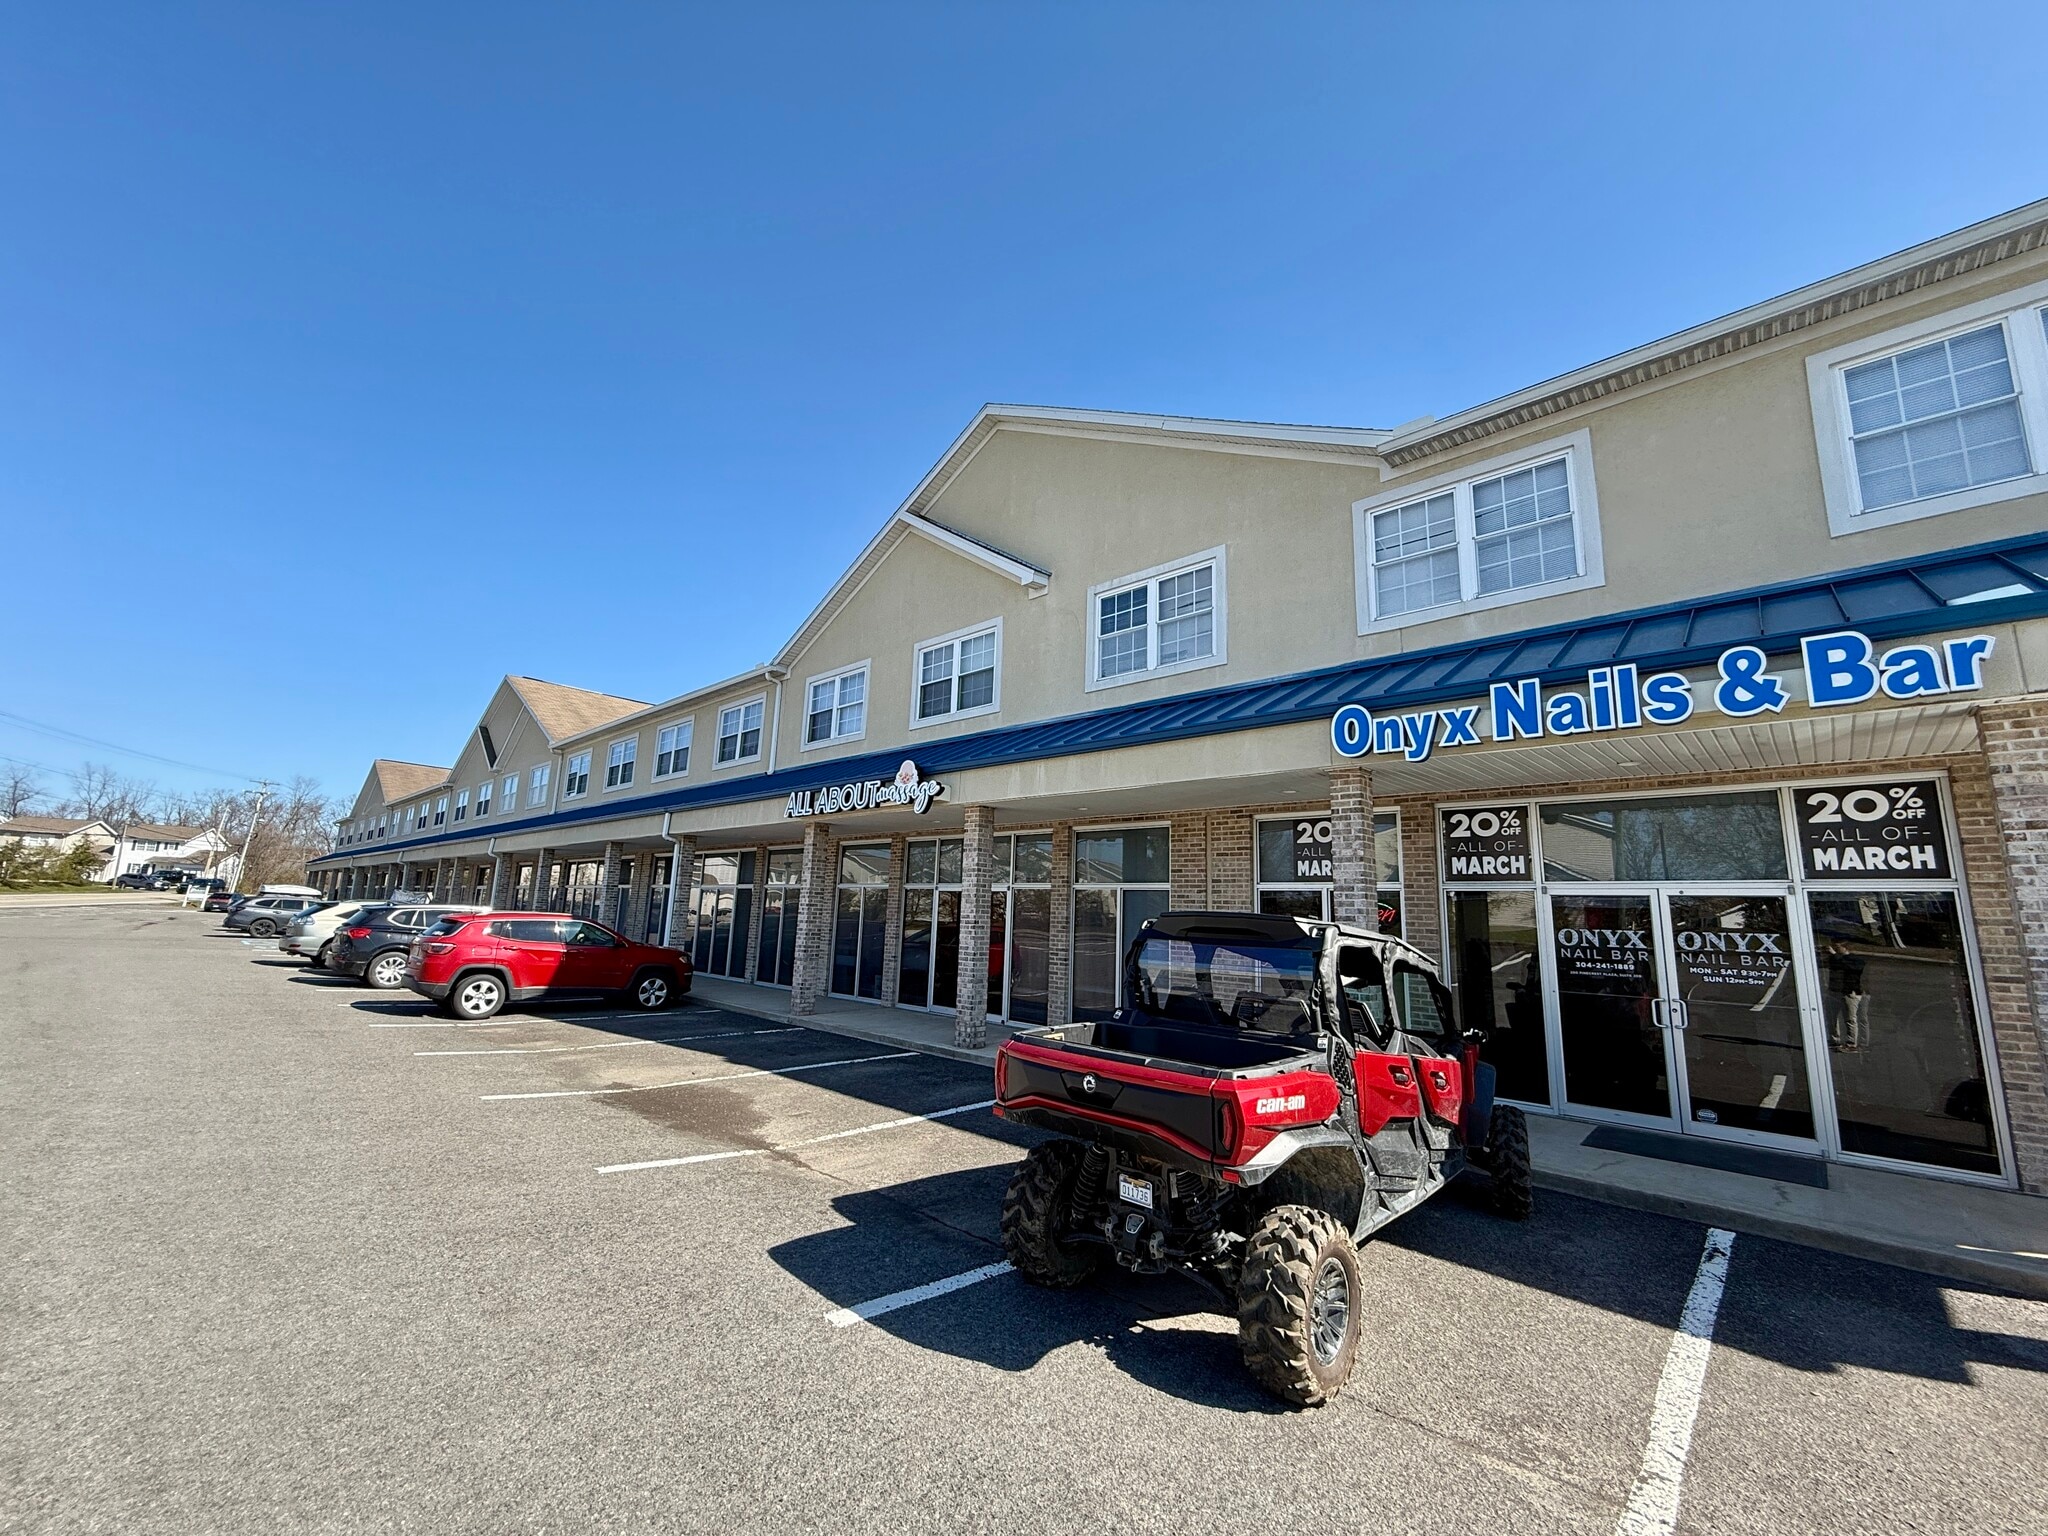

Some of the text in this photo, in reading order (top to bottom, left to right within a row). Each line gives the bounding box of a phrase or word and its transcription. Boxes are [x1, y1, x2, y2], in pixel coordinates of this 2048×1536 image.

[1331, 630, 1996, 762] Onyx Nails & Bar
[784, 779, 940, 818] ALL ABOUT massage
[1806, 787, 1923, 823] 20%
[1449, 810, 1520, 837] 20%
[1892, 808, 1926, 819] OFF
[1296, 821, 1333, 843] 20
[1501, 827, 1521, 835] OFF
[1451, 855, 1525, 875] MARCH
[1812, 845, 1937, 870] MARCH
[1297, 860, 1333, 876] MAR
[1558, 928, 1647, 949] ONYX
[1677, 931, 1783, 954] ONYX
[1561, 948, 1649, 961] NAIL BAR
[1681, 953, 1785, 968] NAIL BAR
[1575, 961, 1635, 970] 304-241-1889
[1689, 967, 1712, 975] MON
[1720, 968, 1738, 976] SAT
